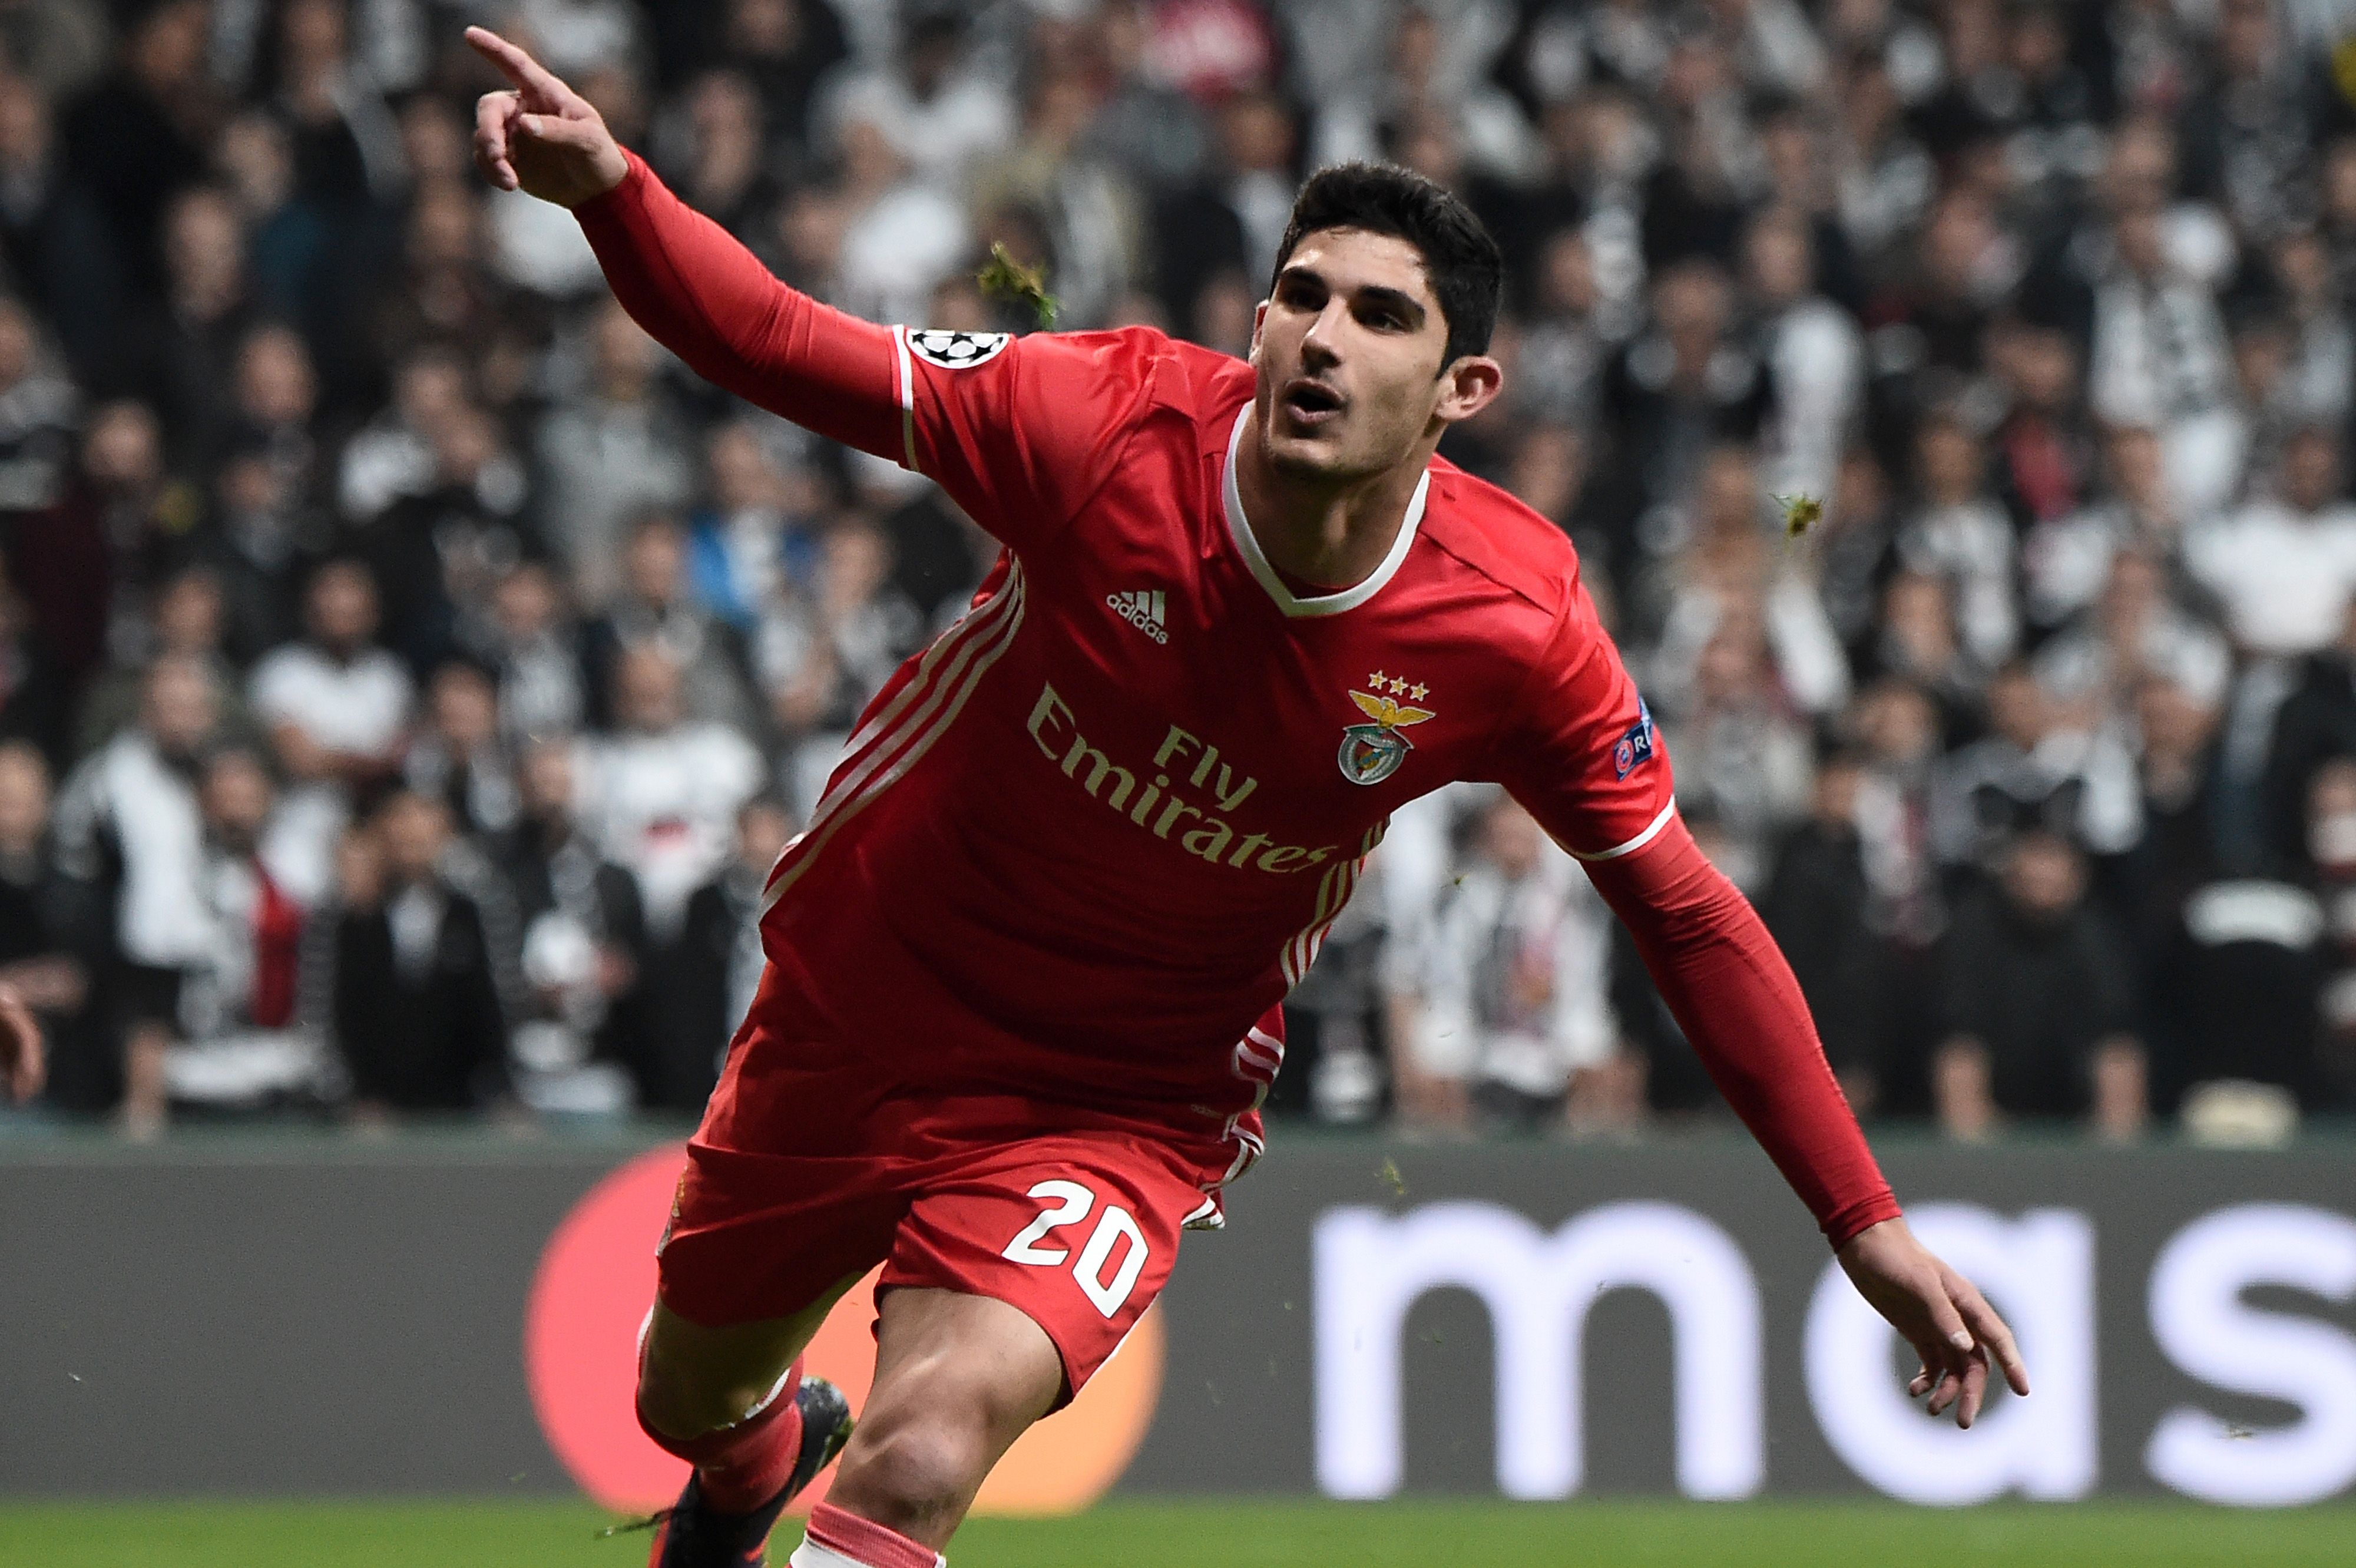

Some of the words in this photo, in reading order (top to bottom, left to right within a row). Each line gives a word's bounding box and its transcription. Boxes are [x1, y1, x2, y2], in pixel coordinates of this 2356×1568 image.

[1106, 594, 1168, 644] adidas
[1027, 681, 1338, 873] Emirates
[1153, 725, 1258, 812] Fly
[1001, 1180, 1149, 1319] 20
[1311, 1199, 2356, 1506] mas
